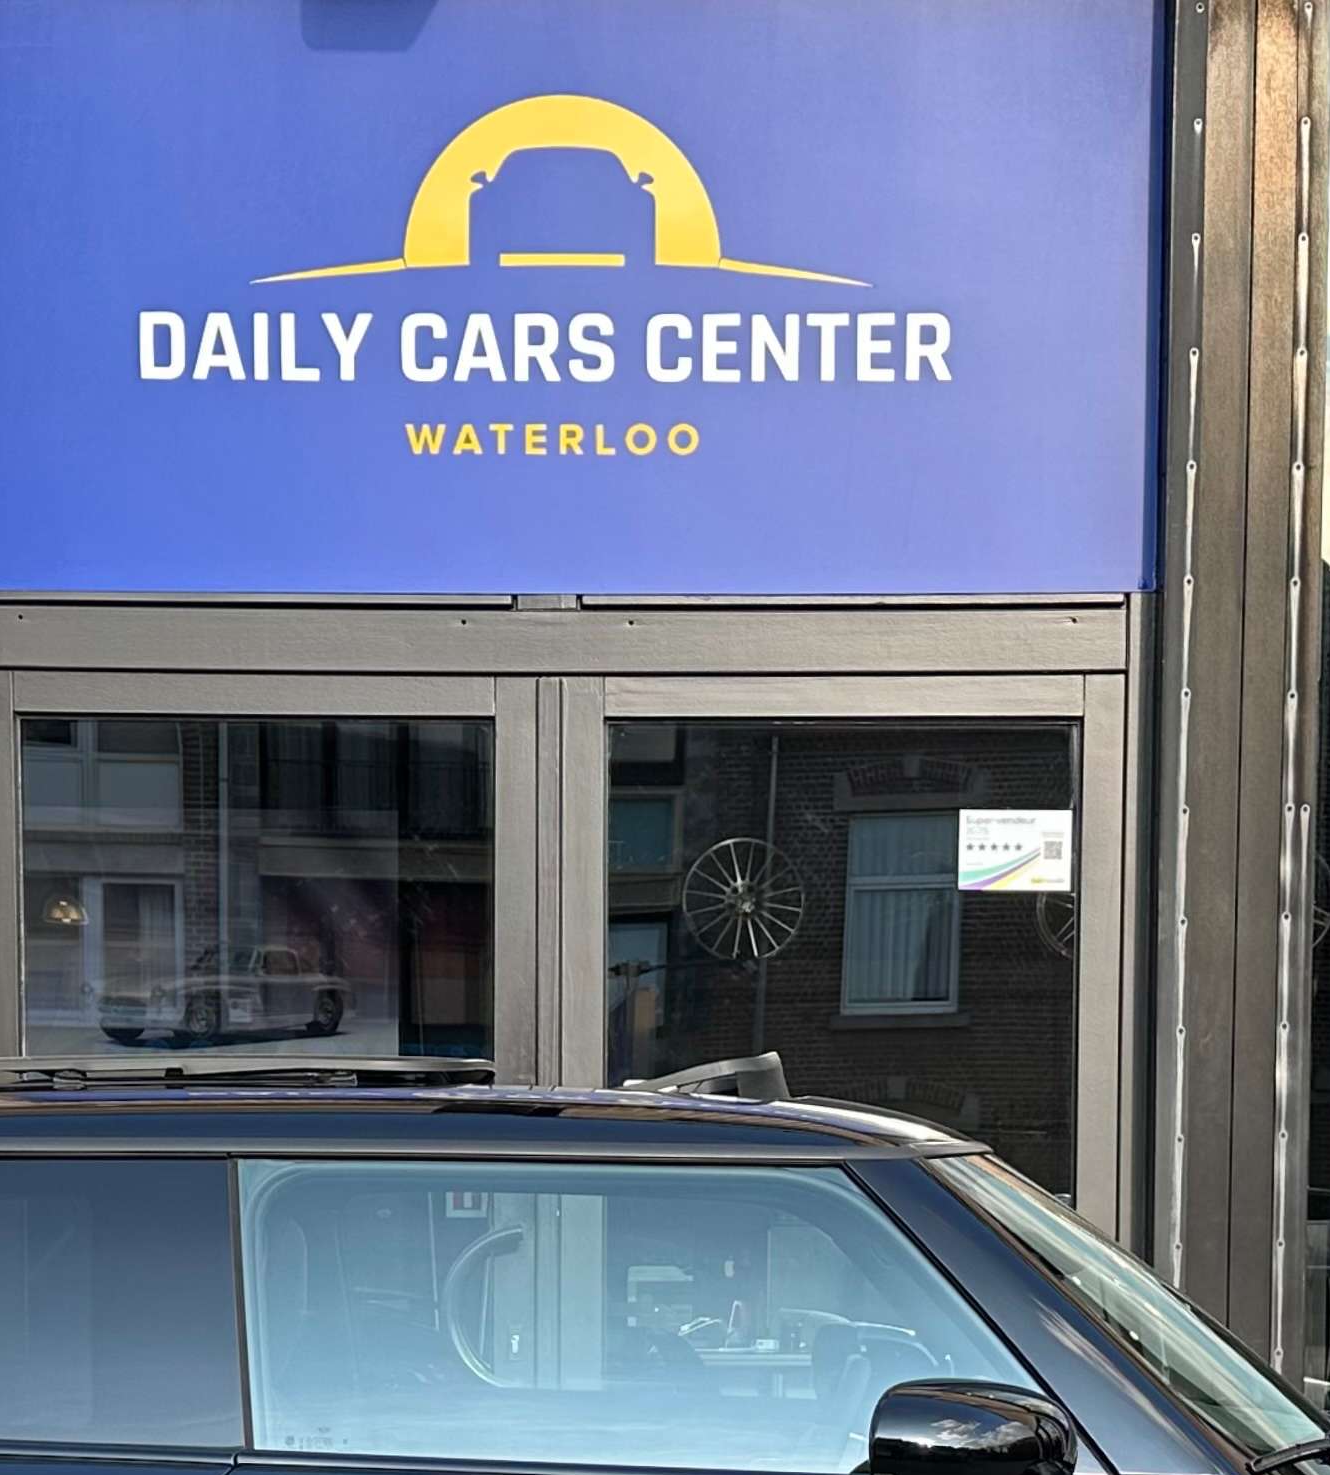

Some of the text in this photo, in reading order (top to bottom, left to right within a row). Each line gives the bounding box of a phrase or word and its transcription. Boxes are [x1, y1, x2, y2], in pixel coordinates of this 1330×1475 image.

[138, 311, 954, 384] DAILY CARS CENTER
[405, 423, 703, 457] WATERLOO
